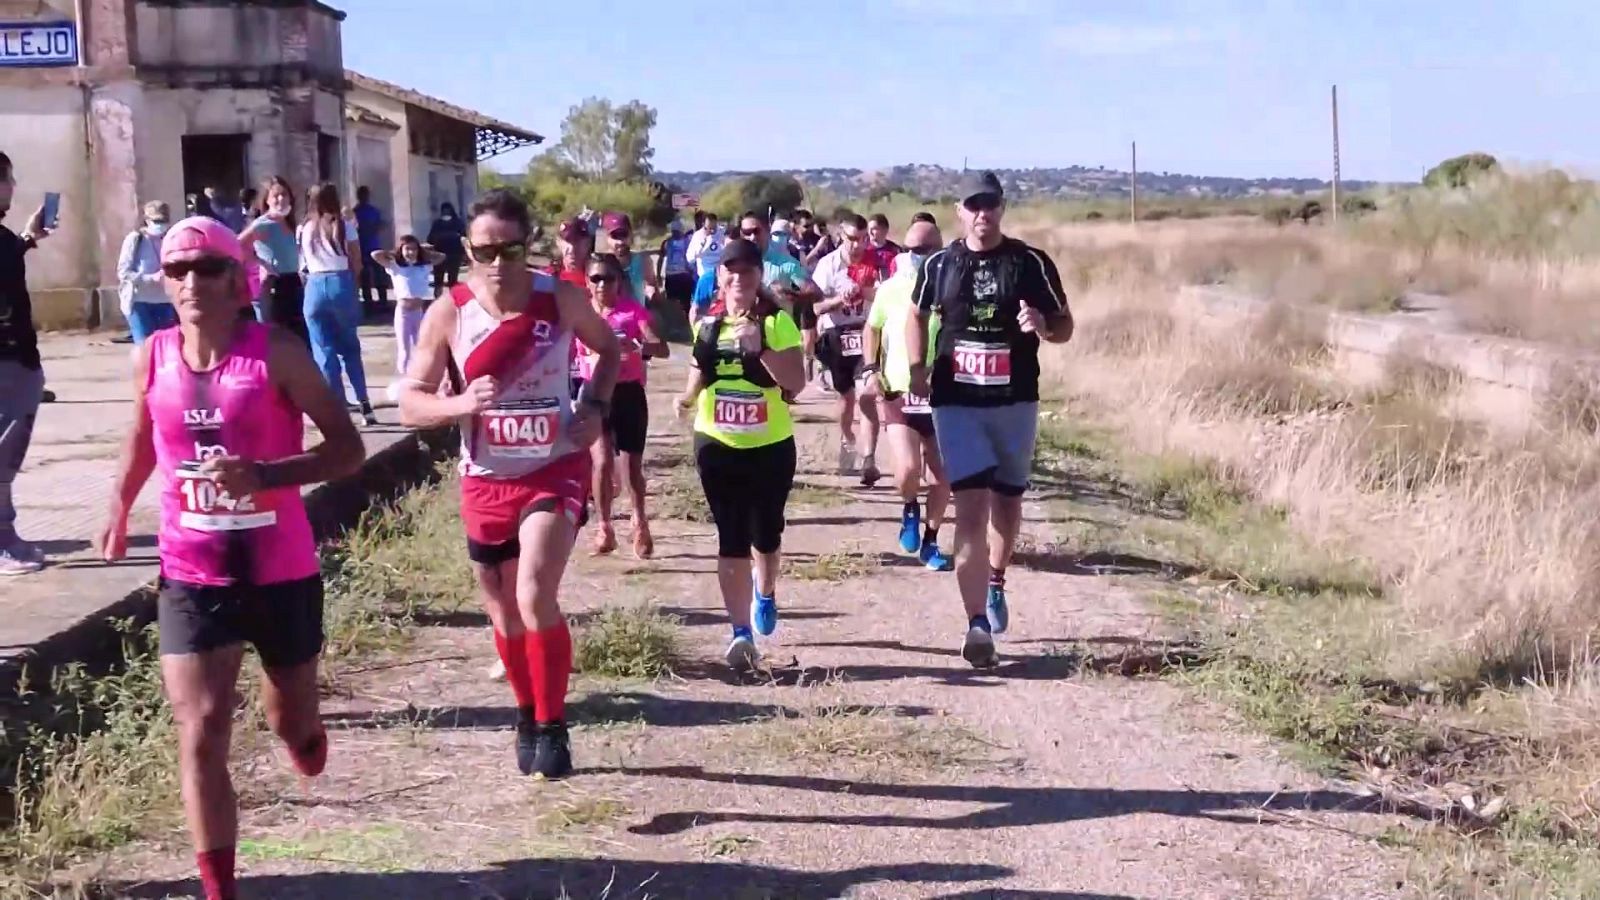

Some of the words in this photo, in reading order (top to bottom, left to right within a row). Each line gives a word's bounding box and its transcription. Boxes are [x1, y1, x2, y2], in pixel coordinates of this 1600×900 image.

[0, 31, 68, 56] LEJO
[956, 352, 997, 375] 1011
[182, 408, 225, 425] ISLA
[716, 401, 759, 424] 1012
[488, 416, 549, 443] 1040
